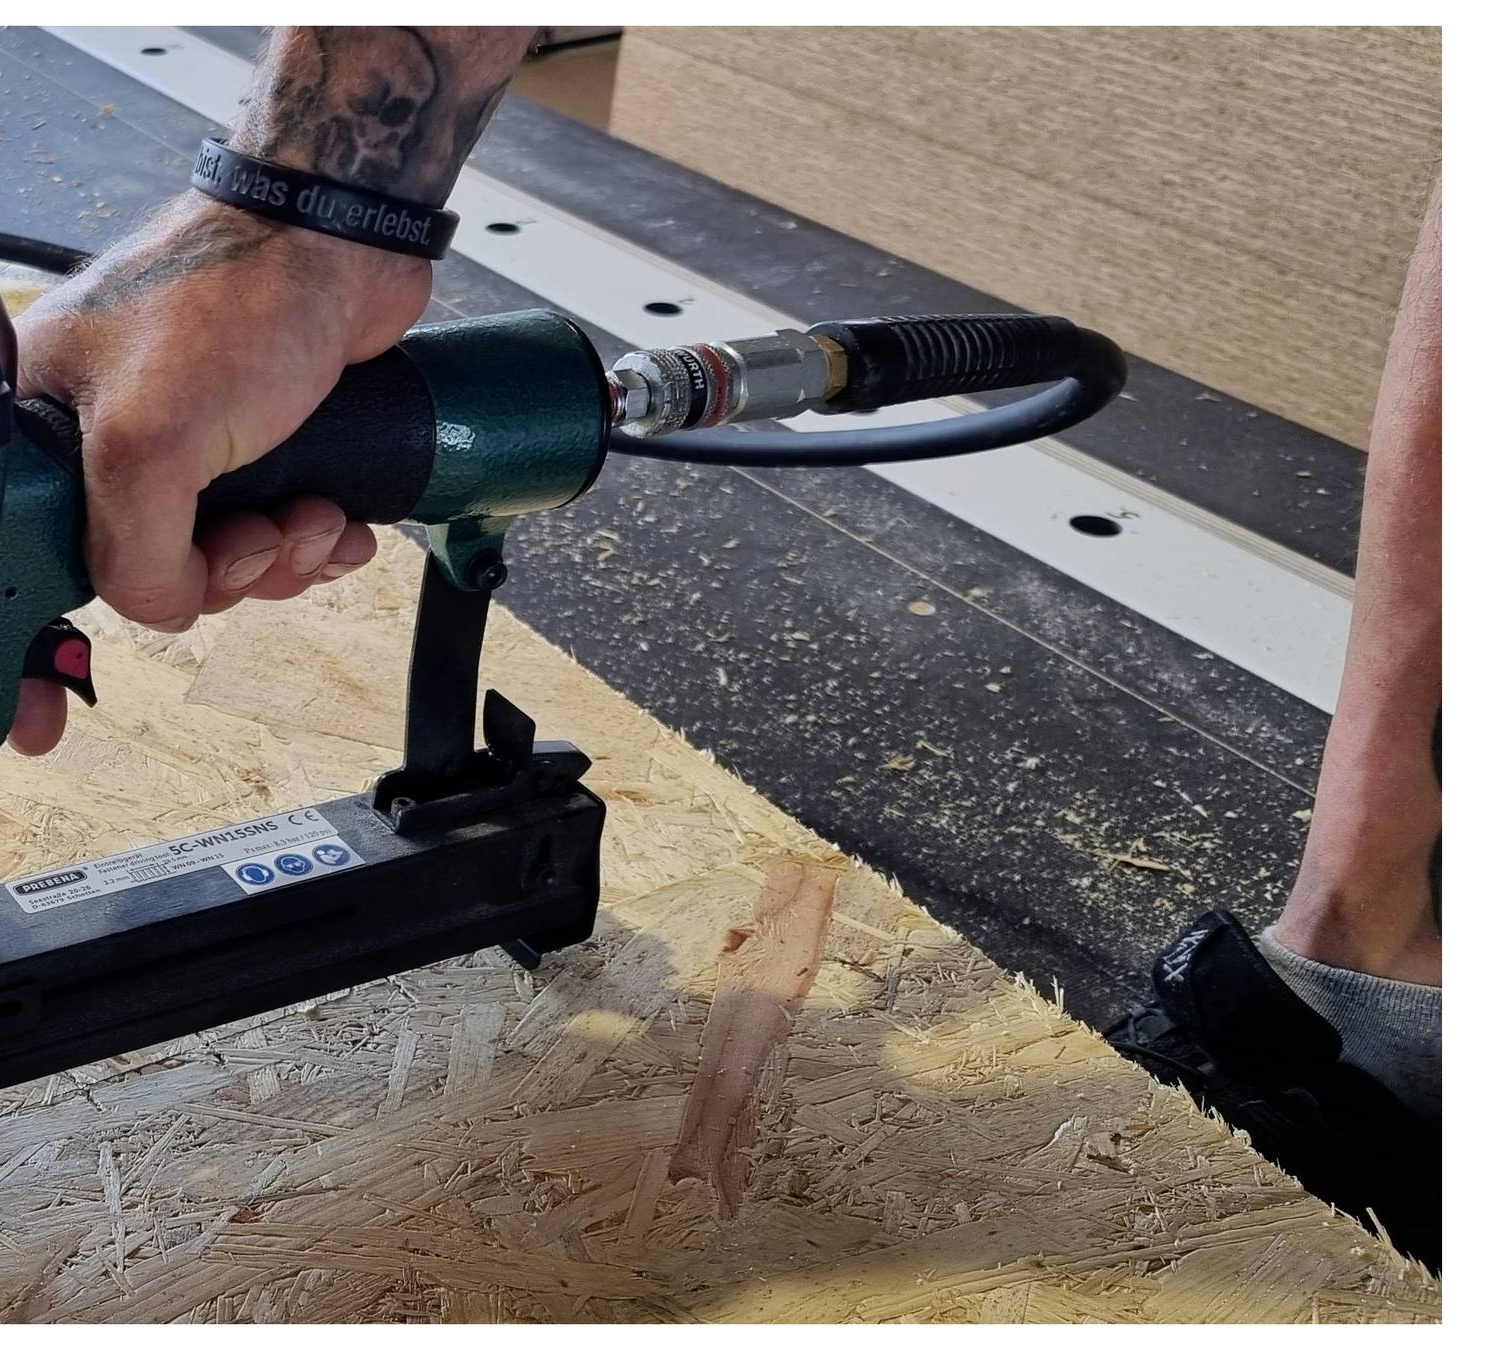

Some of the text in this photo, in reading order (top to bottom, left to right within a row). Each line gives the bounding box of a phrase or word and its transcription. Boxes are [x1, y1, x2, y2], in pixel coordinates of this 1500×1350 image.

[230, 166, 288, 206] was
[296, 184, 334, 219] du
[168, 821, 278, 855] 5C-WN15SNS
[129, 856, 155, 866] driving
[21, 872, 80, 892] PREBENA
[67, 888, 101, 900] Schotten
